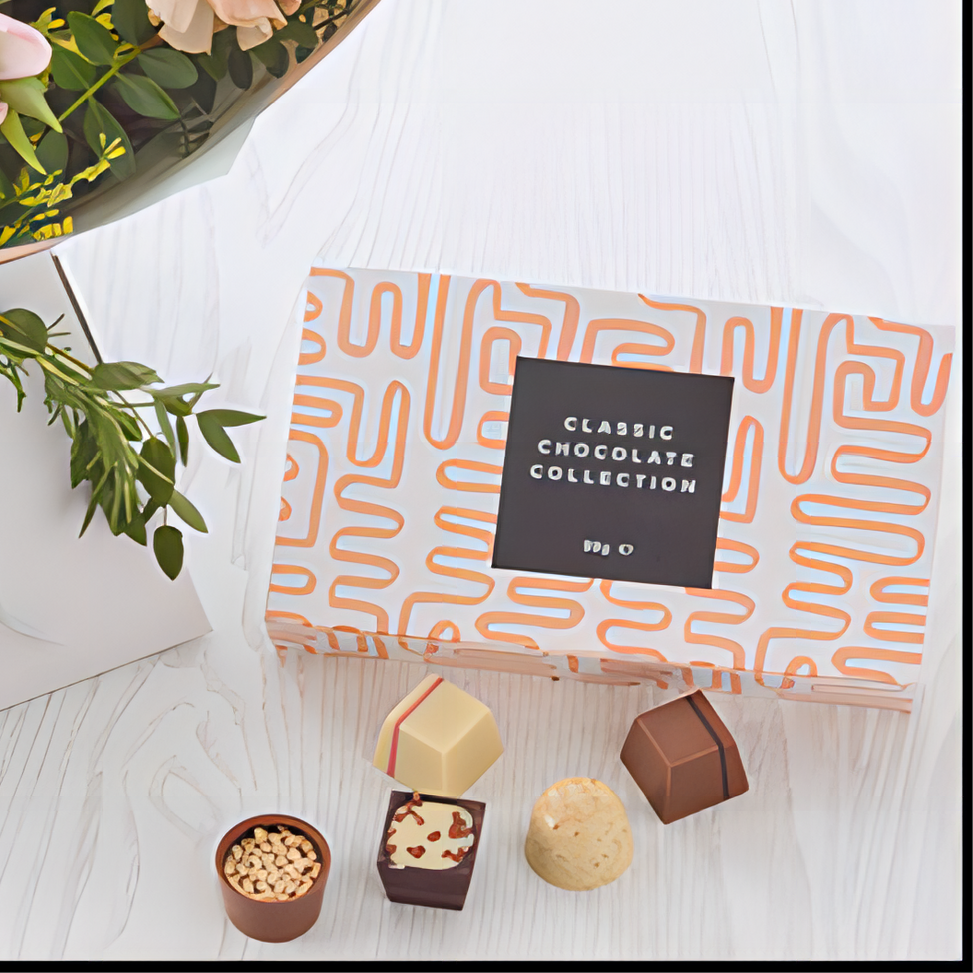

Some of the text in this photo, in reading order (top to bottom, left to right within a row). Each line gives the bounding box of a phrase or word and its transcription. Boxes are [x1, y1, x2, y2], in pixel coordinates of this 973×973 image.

[563, 416, 674, 440] CLASSIC
[537, 439, 694, 467] CHOCOLATE
[529, 464, 696, 493] COLLECTION
